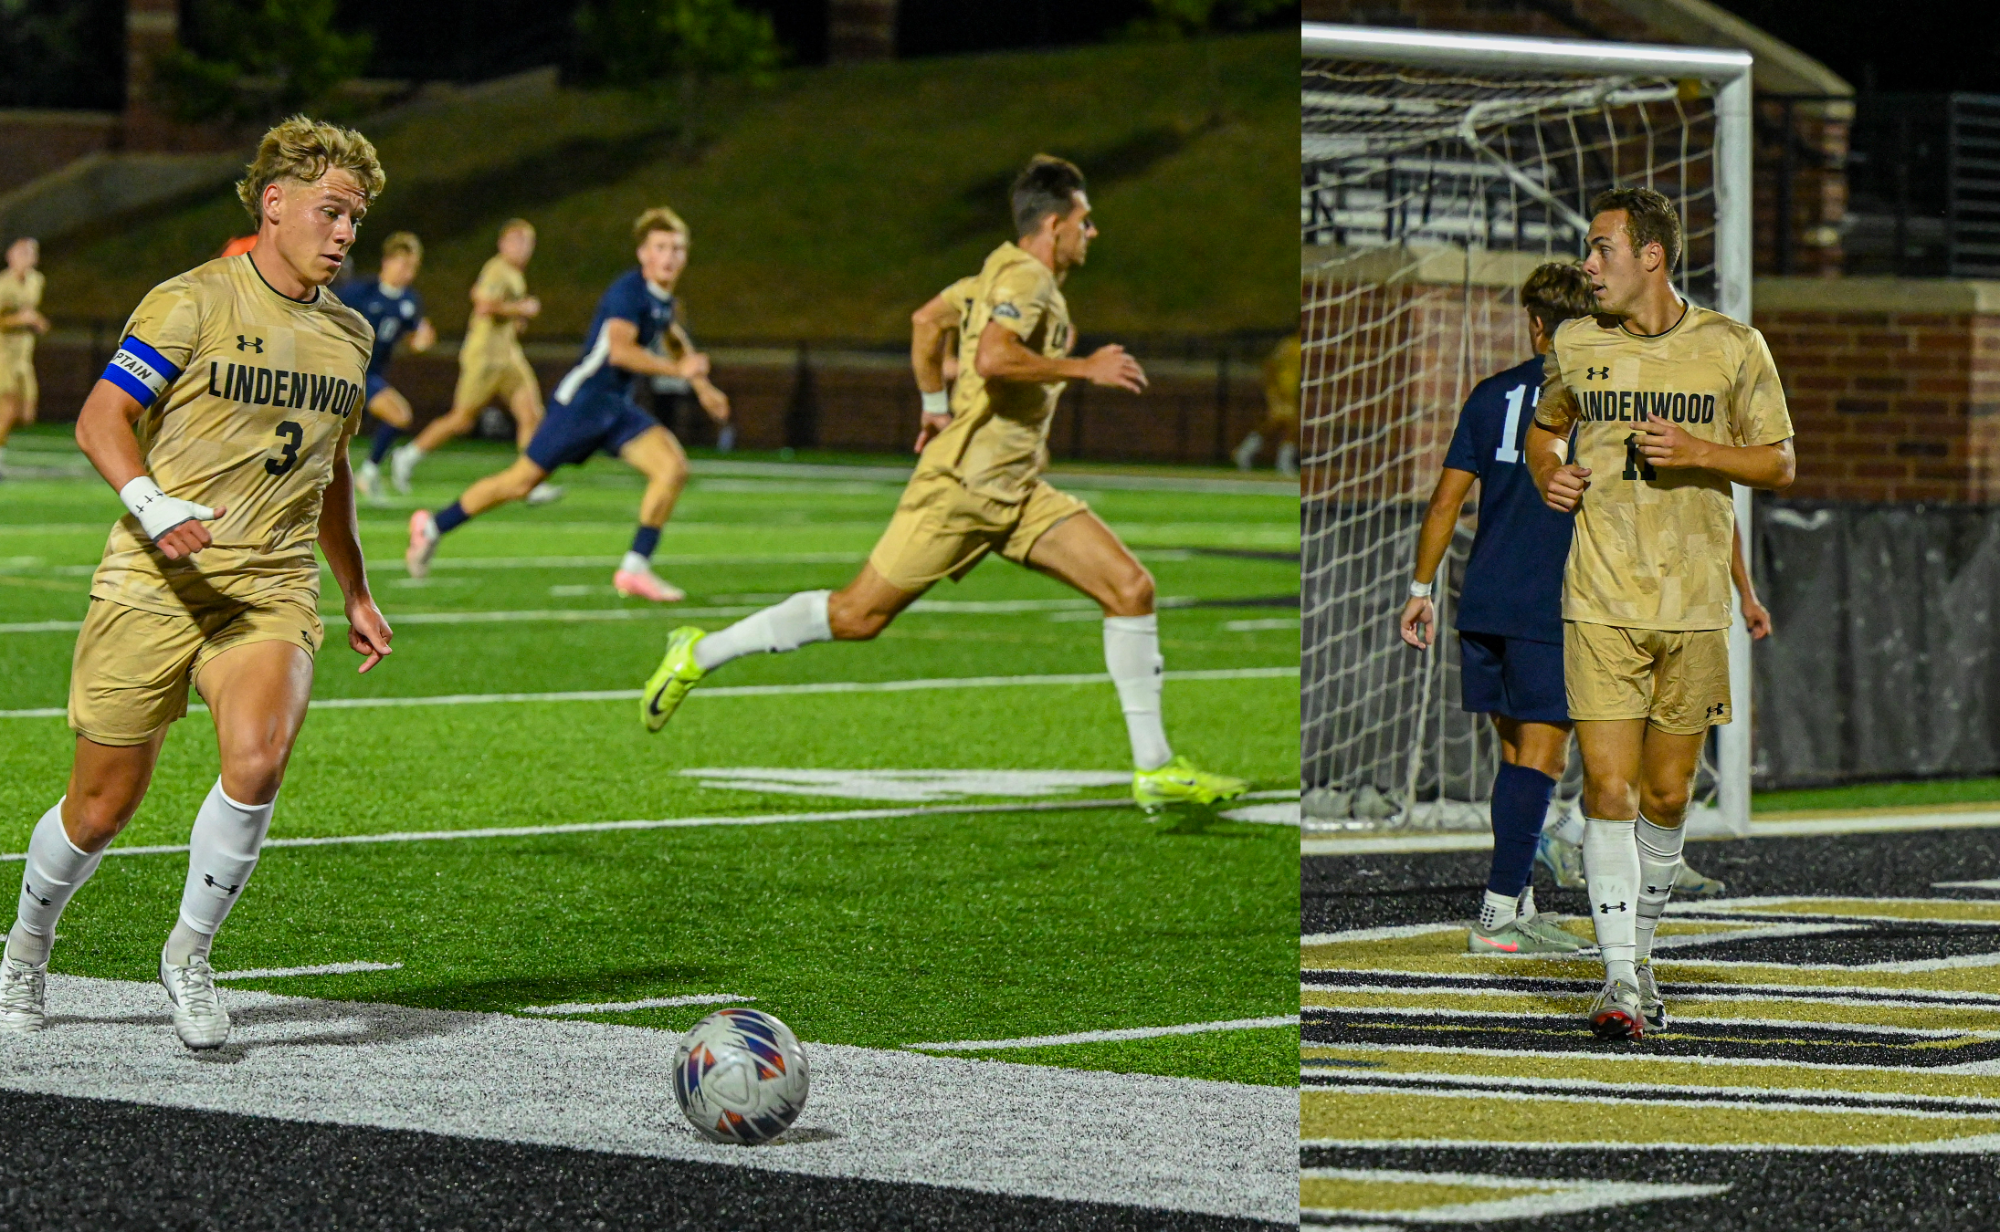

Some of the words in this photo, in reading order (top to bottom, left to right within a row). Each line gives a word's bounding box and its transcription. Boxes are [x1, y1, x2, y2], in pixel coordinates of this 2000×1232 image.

[113, 351, 152, 380] PTAIN
[209, 361, 360, 419] LINDENWOO
[264, 420, 303, 476] 3
[1495, 384, 1541, 464] 1
